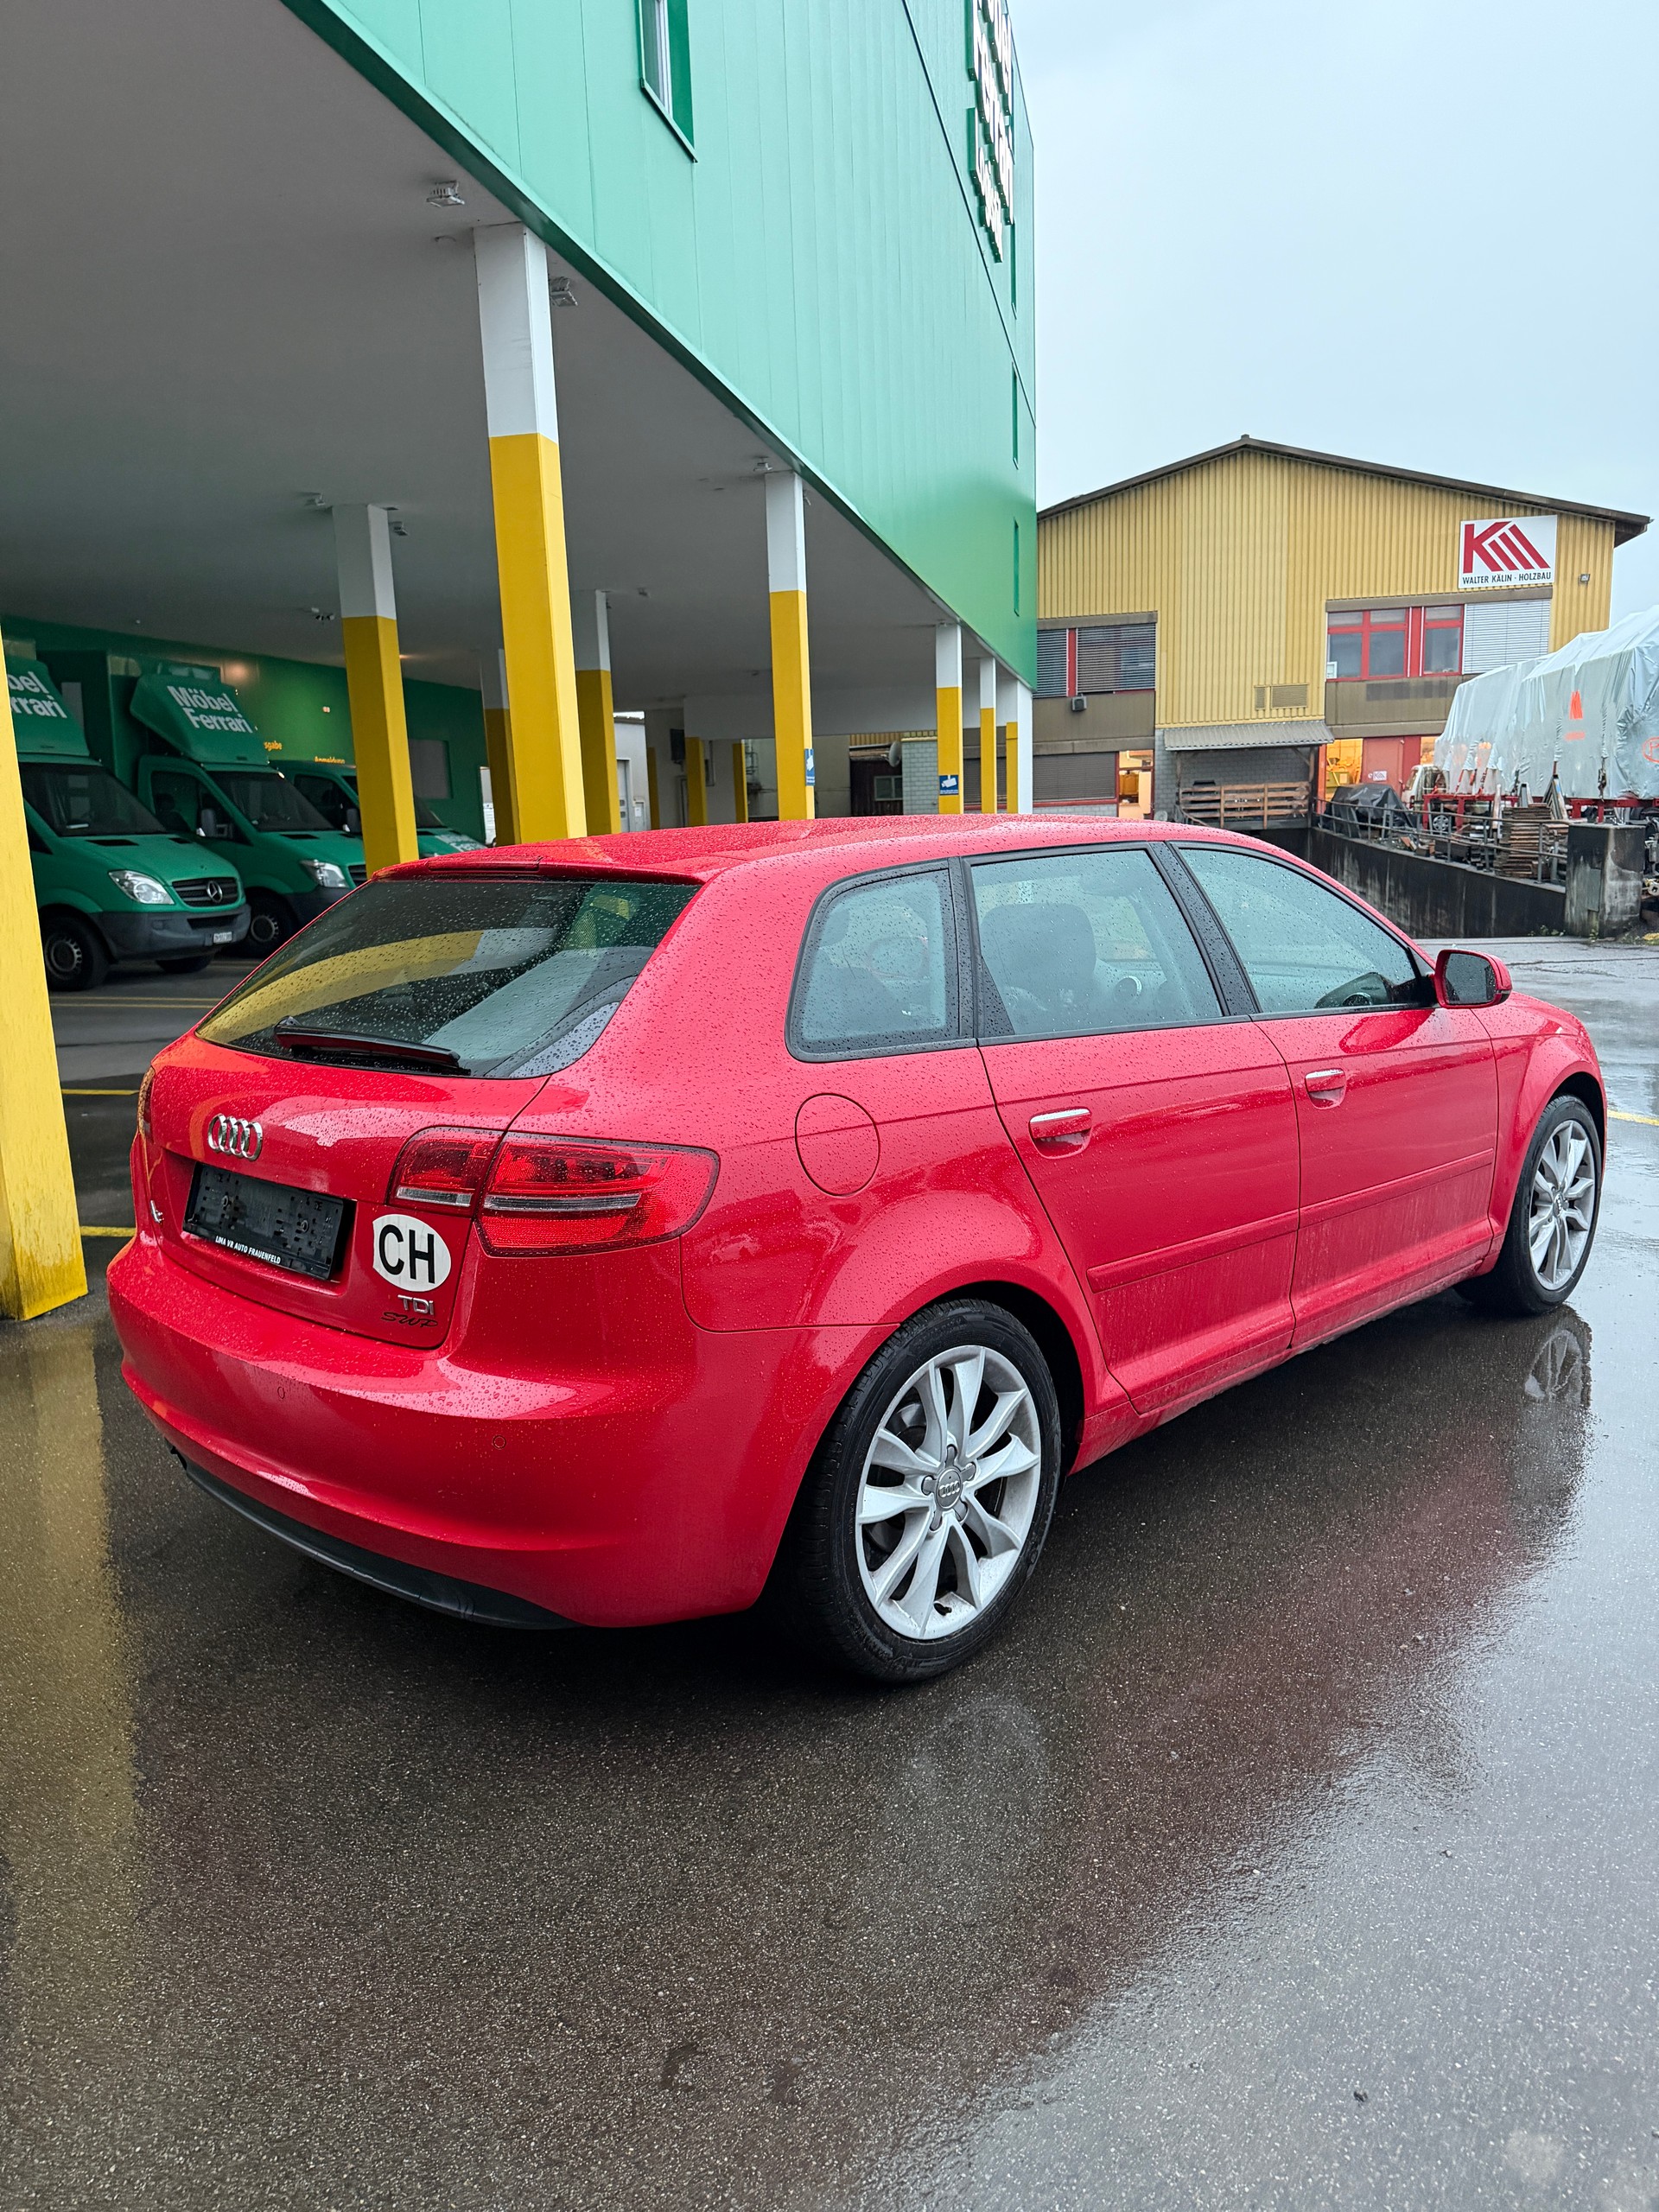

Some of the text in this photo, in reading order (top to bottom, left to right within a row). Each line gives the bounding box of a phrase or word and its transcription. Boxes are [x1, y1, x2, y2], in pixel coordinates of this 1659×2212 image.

[1463, 575, 1489, 584] WALTER
[1491, 572, 1512, 583] KÄLIN
[1518, 572, 1551, 581] HOLZBAU
[167, 685, 238, 713] Möbel
[181, 707, 253, 734] Ferrari
[234, 1243, 248, 1254] AUTO
[248, 1247, 281, 1264] FRAUENFELD
[378, 1224, 436, 1284] CH
